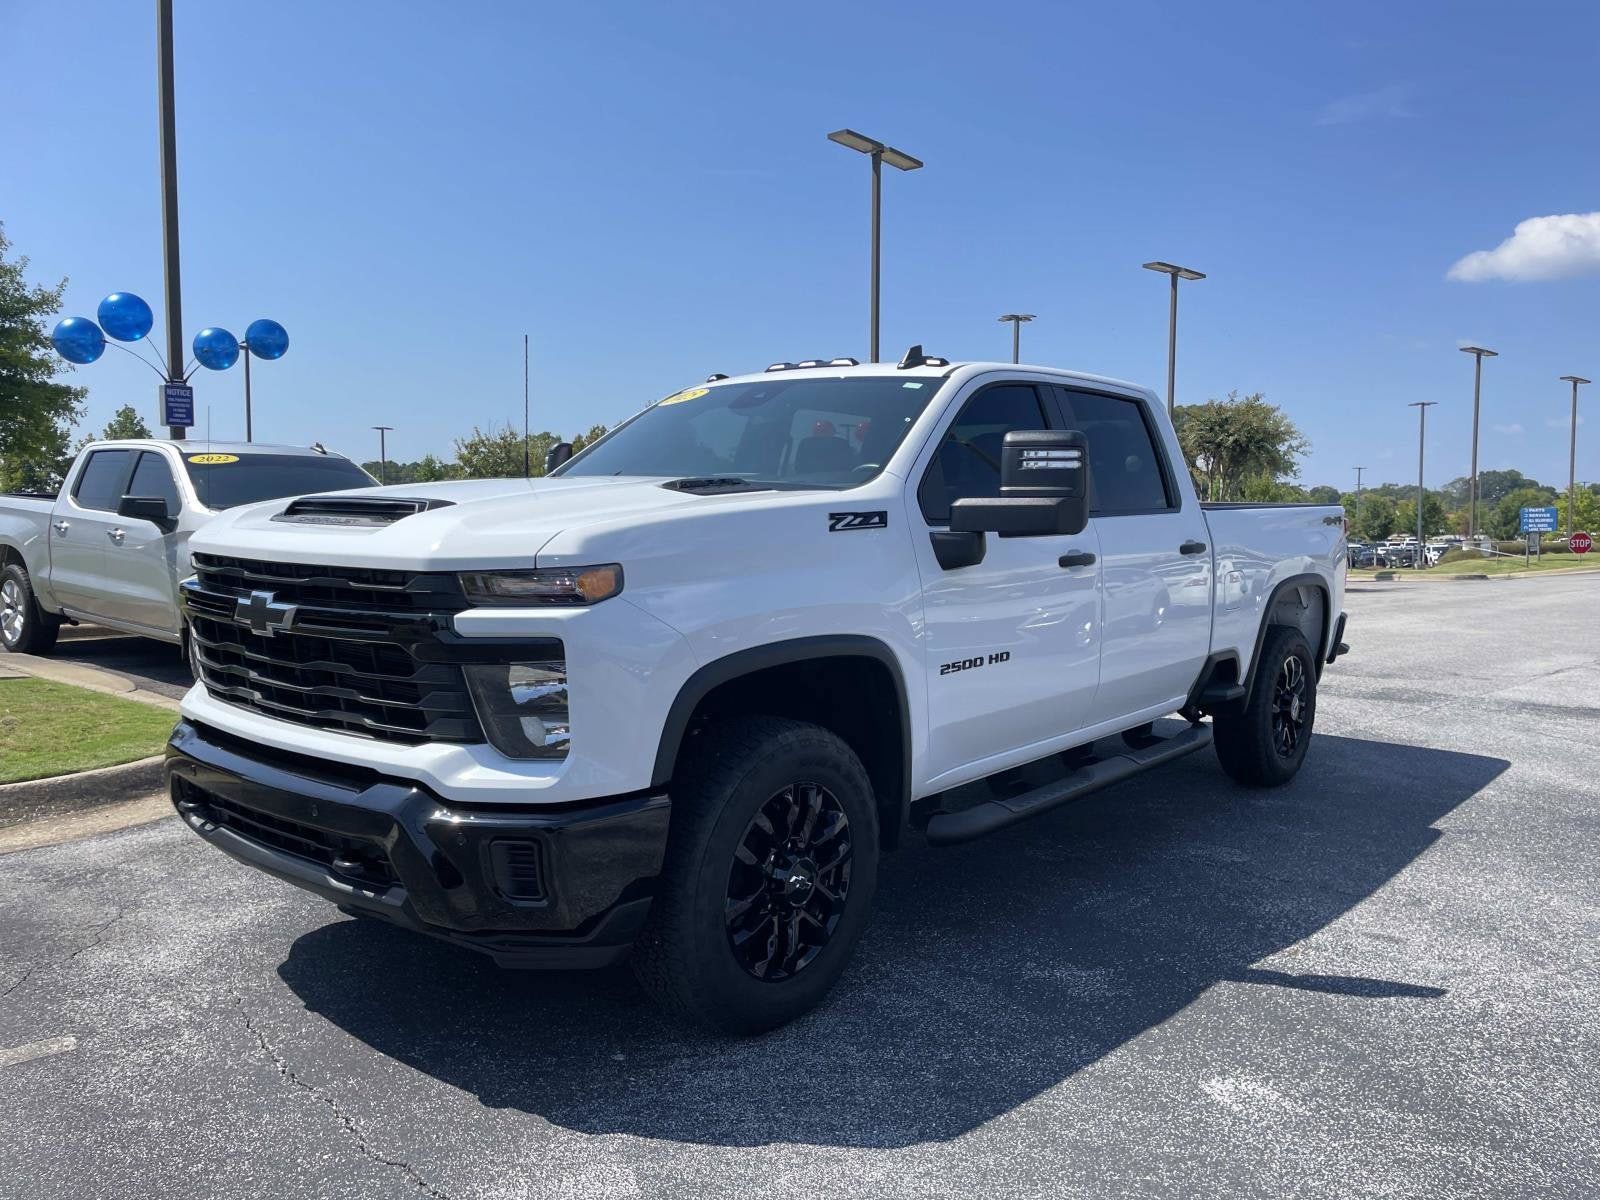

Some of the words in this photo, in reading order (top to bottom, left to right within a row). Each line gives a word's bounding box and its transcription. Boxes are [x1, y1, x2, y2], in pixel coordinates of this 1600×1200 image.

[166, 388, 192, 397] NOTICE
[198, 455, 230, 463] 2022
[297, 516, 361, 525] CHEVROLET
[829, 511, 888, 532] Z71
[1570, 539, 1591, 548] STOP
[940, 656, 984, 675] 2500
[988, 651, 1010, 664] HD
